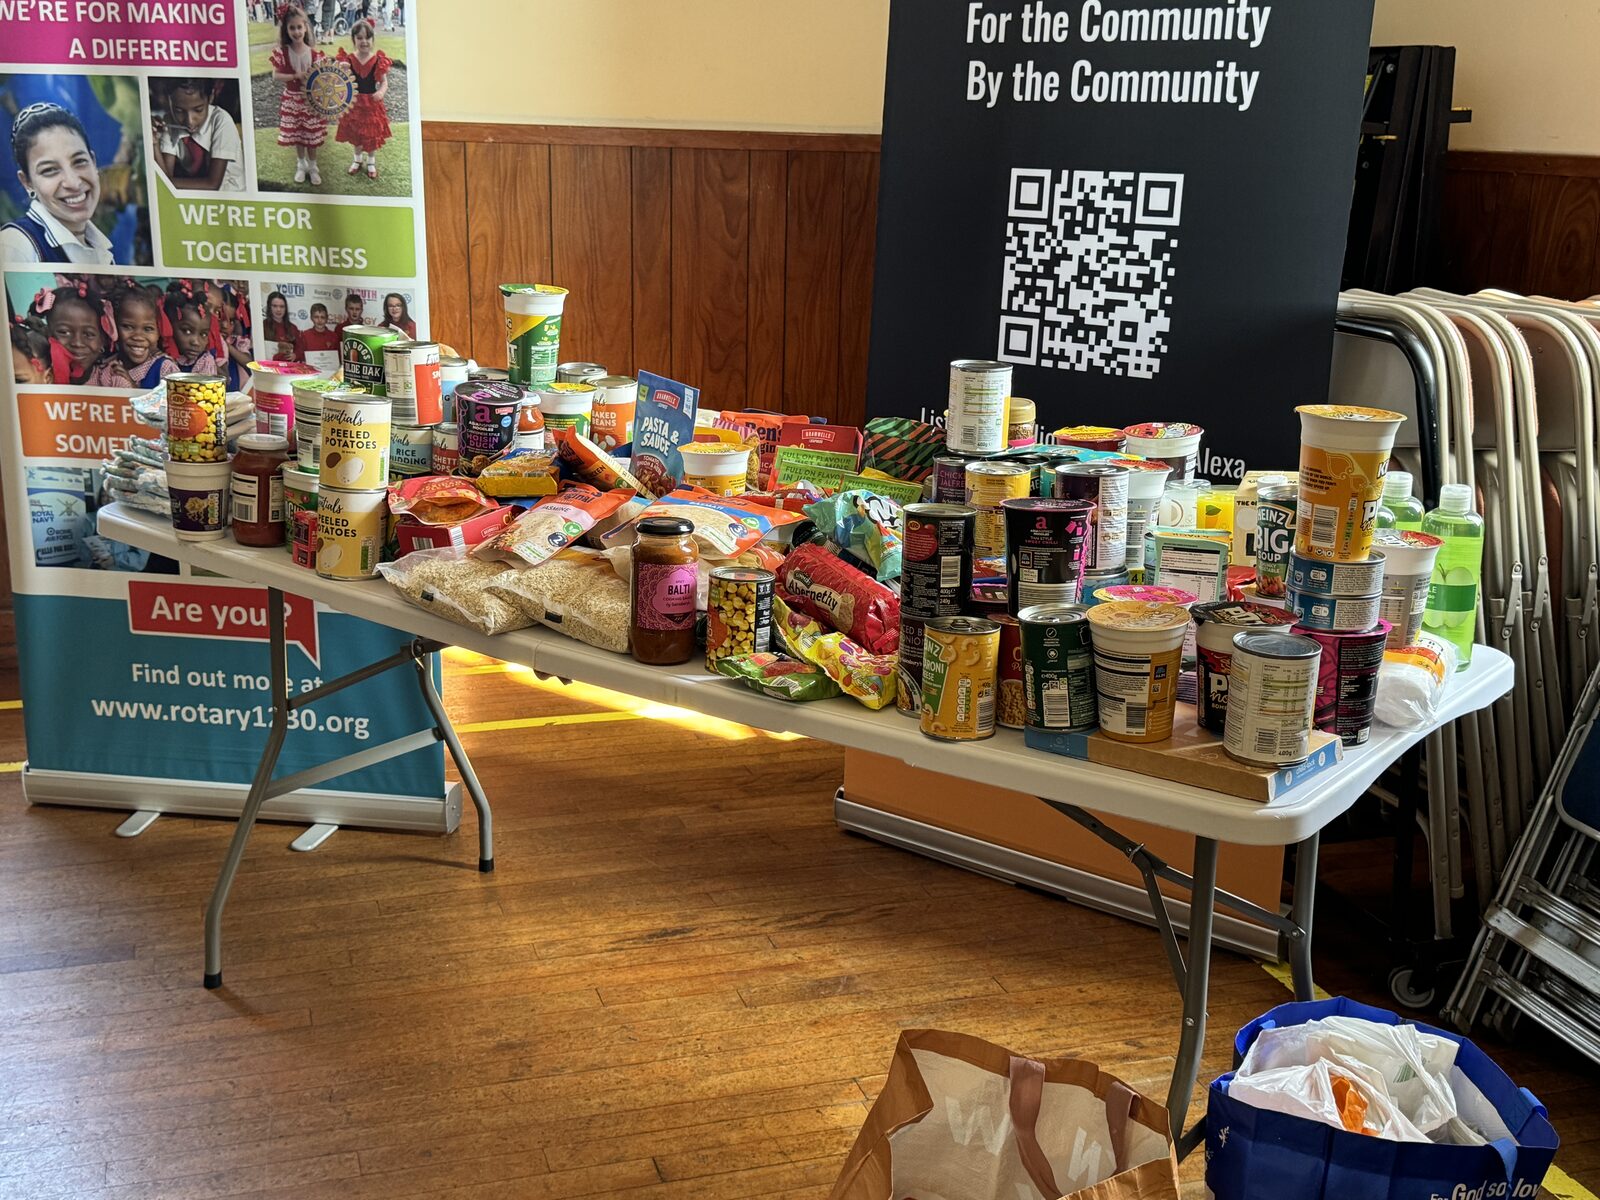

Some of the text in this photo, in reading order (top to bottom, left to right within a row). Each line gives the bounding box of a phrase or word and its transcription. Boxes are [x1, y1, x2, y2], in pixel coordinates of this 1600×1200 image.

[76, 2, 121, 24] FOR
[128, 2, 225, 26] MAKING
[966, 0, 1271, 48] For the Community
[69, 38, 228, 62] A DIFFERENCE
[966, 59, 1260, 111] By the Community
[180, 203, 312, 230] WE'RE FOR
[182, 240, 368, 271] TOGETHERNESS
[352, 341, 371, 360] DOGS
[362, 364, 381, 377] OAK
[44, 401, 116, 424] WE'RE
[331, 427, 371, 439] PEELED
[467, 433, 499, 444] HOISIN
[640, 416, 680, 446] PASTA &
[325, 436, 377, 449] POTATOES
[469, 439, 495, 450] DUCK
[641, 432, 671, 457] SAUCE
[396, 448, 417, 457] RICE
[782, 451, 800, 459] FULL
[815, 454, 852, 465] FLAVOUR
[783, 473, 794, 481] IN
[824, 478, 841, 487] MIN
[785, 465, 840, 479] FULL ON FLAVO
[882, 483, 916, 496] FLAVOUR
[541, 505, 573, 513] JASMINE
[318, 524, 357, 537] OTATOES
[553, 535, 563, 546] 2
[1253, 525, 1290, 555] BIG
[1257, 550, 1282, 563] SOUP
[668, 584, 690, 595] BALTI
[788, 579, 838, 611] Abernethy
[150, 595, 203, 622] Are
[211, 602, 268, 629] you
[132, 662, 181, 685] Find
[186, 669, 227, 689] out
[232, 672, 293, 692] moe
[91, 698, 370, 740] www.rotary130.org
